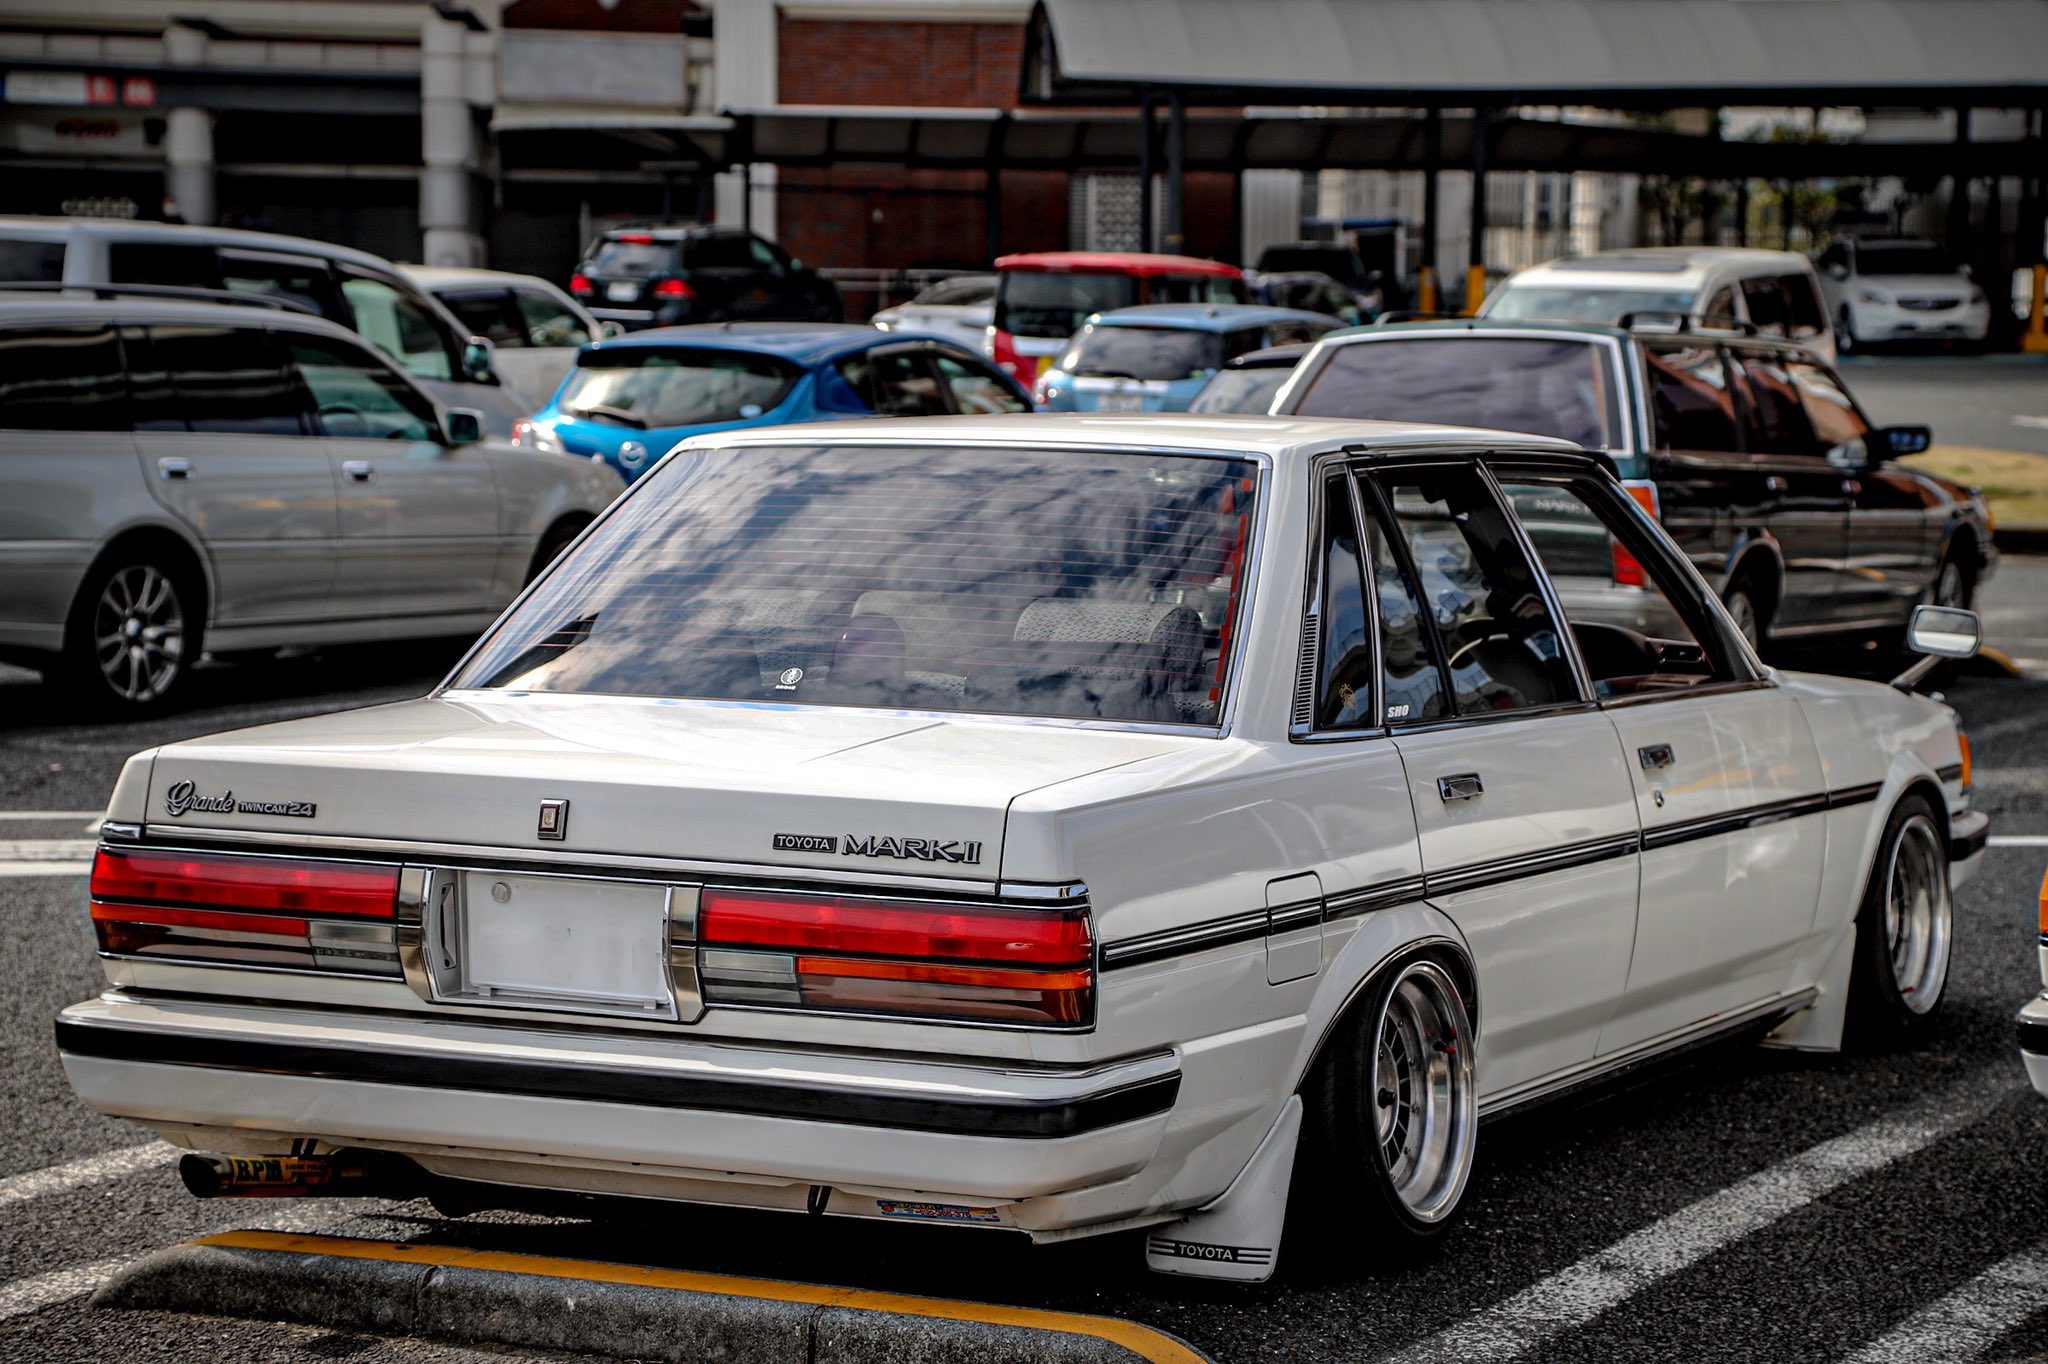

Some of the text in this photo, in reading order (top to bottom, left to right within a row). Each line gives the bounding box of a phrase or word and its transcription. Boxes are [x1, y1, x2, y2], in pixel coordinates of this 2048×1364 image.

[1063, 664, 1126, 676] KENWOOD
[1387, 704, 1410, 718] SHO
[164, 779, 235, 817] Grande
[288, 803, 314, 816] 24
[777, 835, 830, 850] TOYOTA
[236, 1159, 284, 1182] RPM
[1178, 1244, 1234, 1260] TOYOTA
